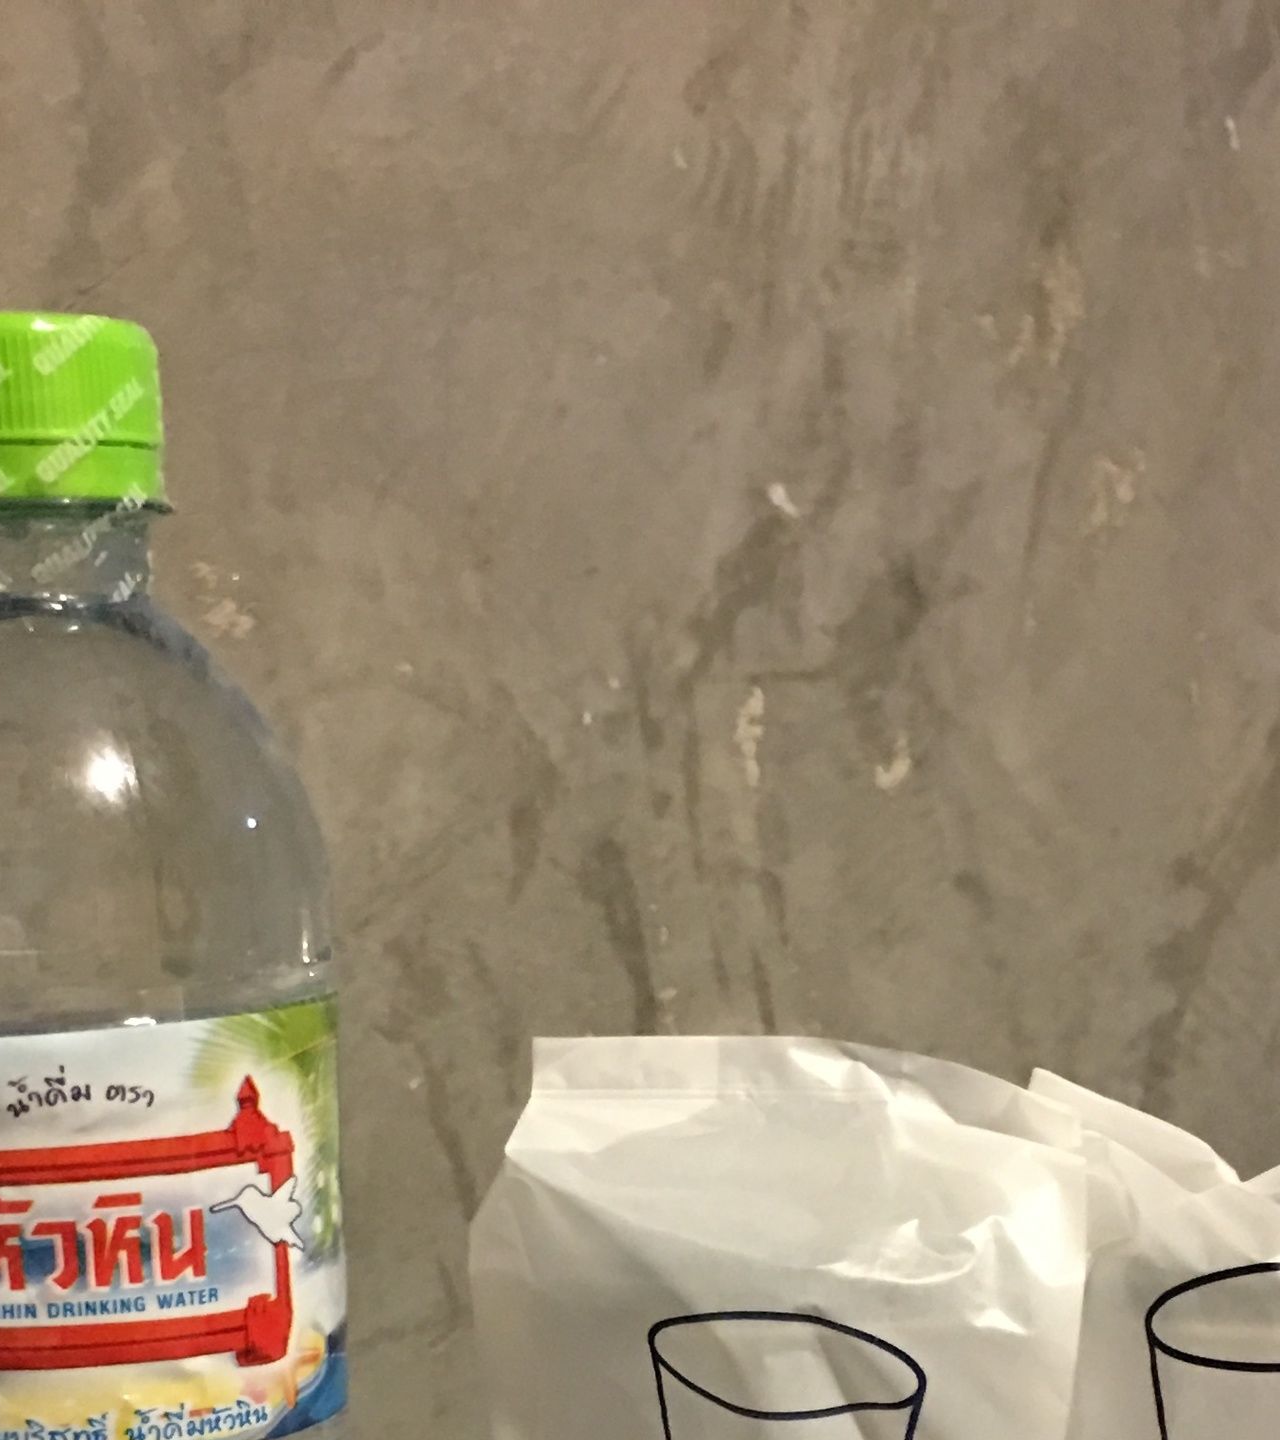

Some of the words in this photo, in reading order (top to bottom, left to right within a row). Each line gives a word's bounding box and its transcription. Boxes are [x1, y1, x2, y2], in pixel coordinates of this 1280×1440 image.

[6, 1064, 91, 1118] น้ำดื่ม
[105, 1083, 155, 1108] ตรา
[47, 1296, 146, 1319] DRINKING
[156, 1287, 219, 1310] WATER
